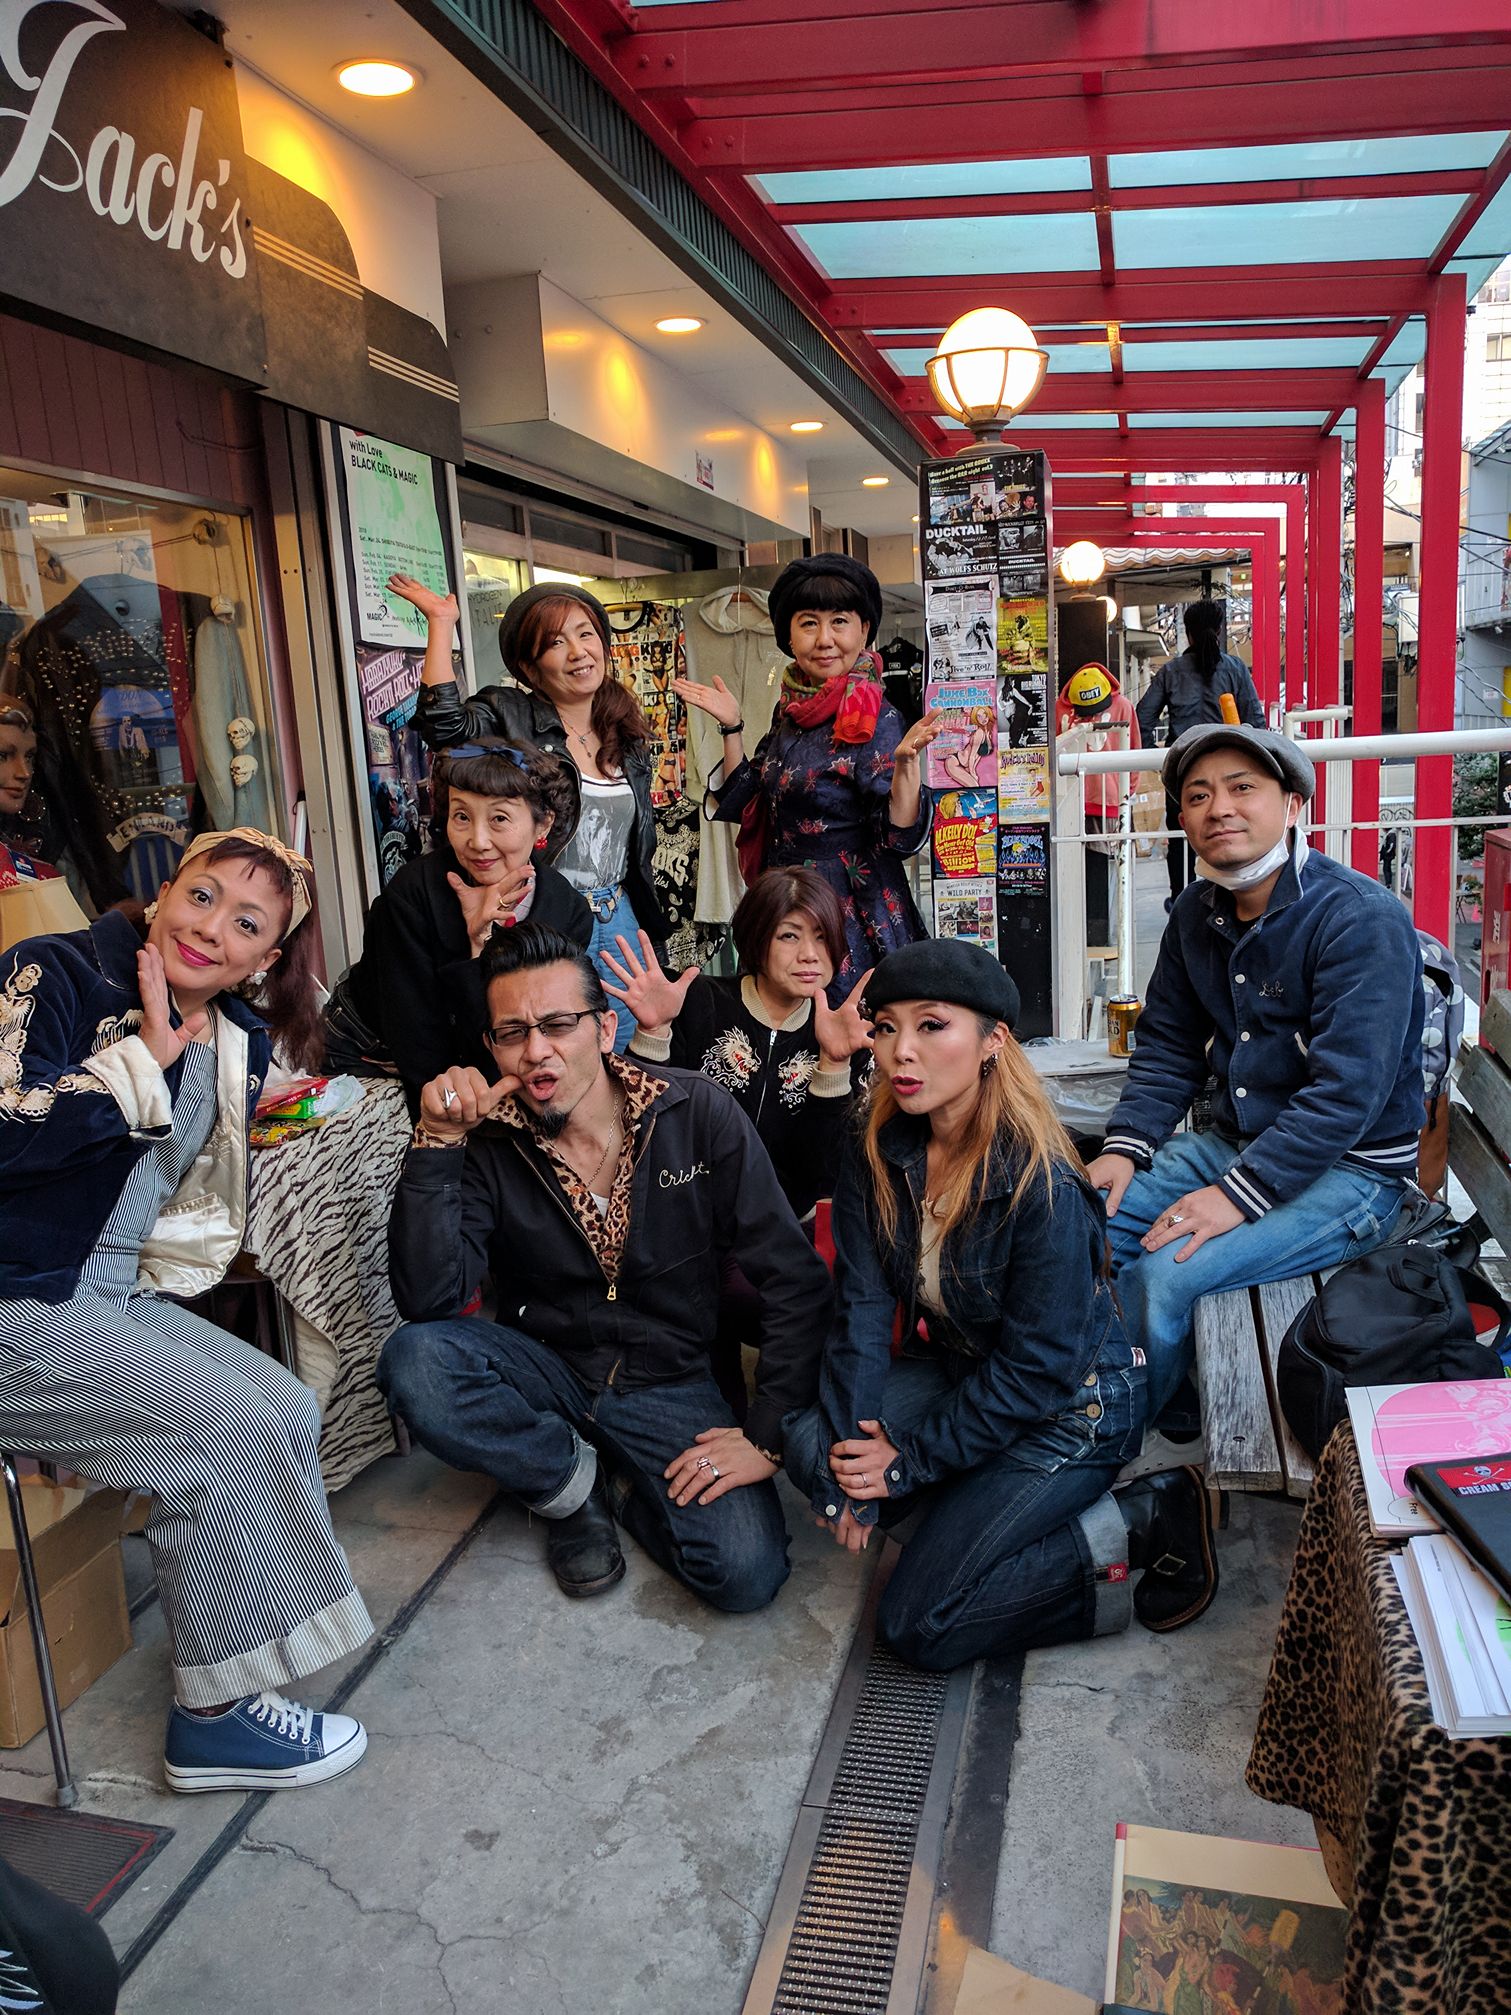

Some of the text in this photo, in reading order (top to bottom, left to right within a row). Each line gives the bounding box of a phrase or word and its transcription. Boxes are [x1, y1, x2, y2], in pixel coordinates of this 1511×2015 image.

[0, 0, 248, 279] Jack's
[349, 440, 382, 458] with Love
[352, 455, 418, 485] BLACK CATS & MAGIC
[926, 524, 987, 539] DUCKTAIL
[972, 563, 998, 572] SCHUTZ
[366, 612, 382, 622] MAGIC
[643, 692, 674, 706] KIG
[1081, 687, 1099, 699] OBEY
[1458, 1483, 1500, 1495] CREAM
[1408, 1502, 1418, 1514] Free
